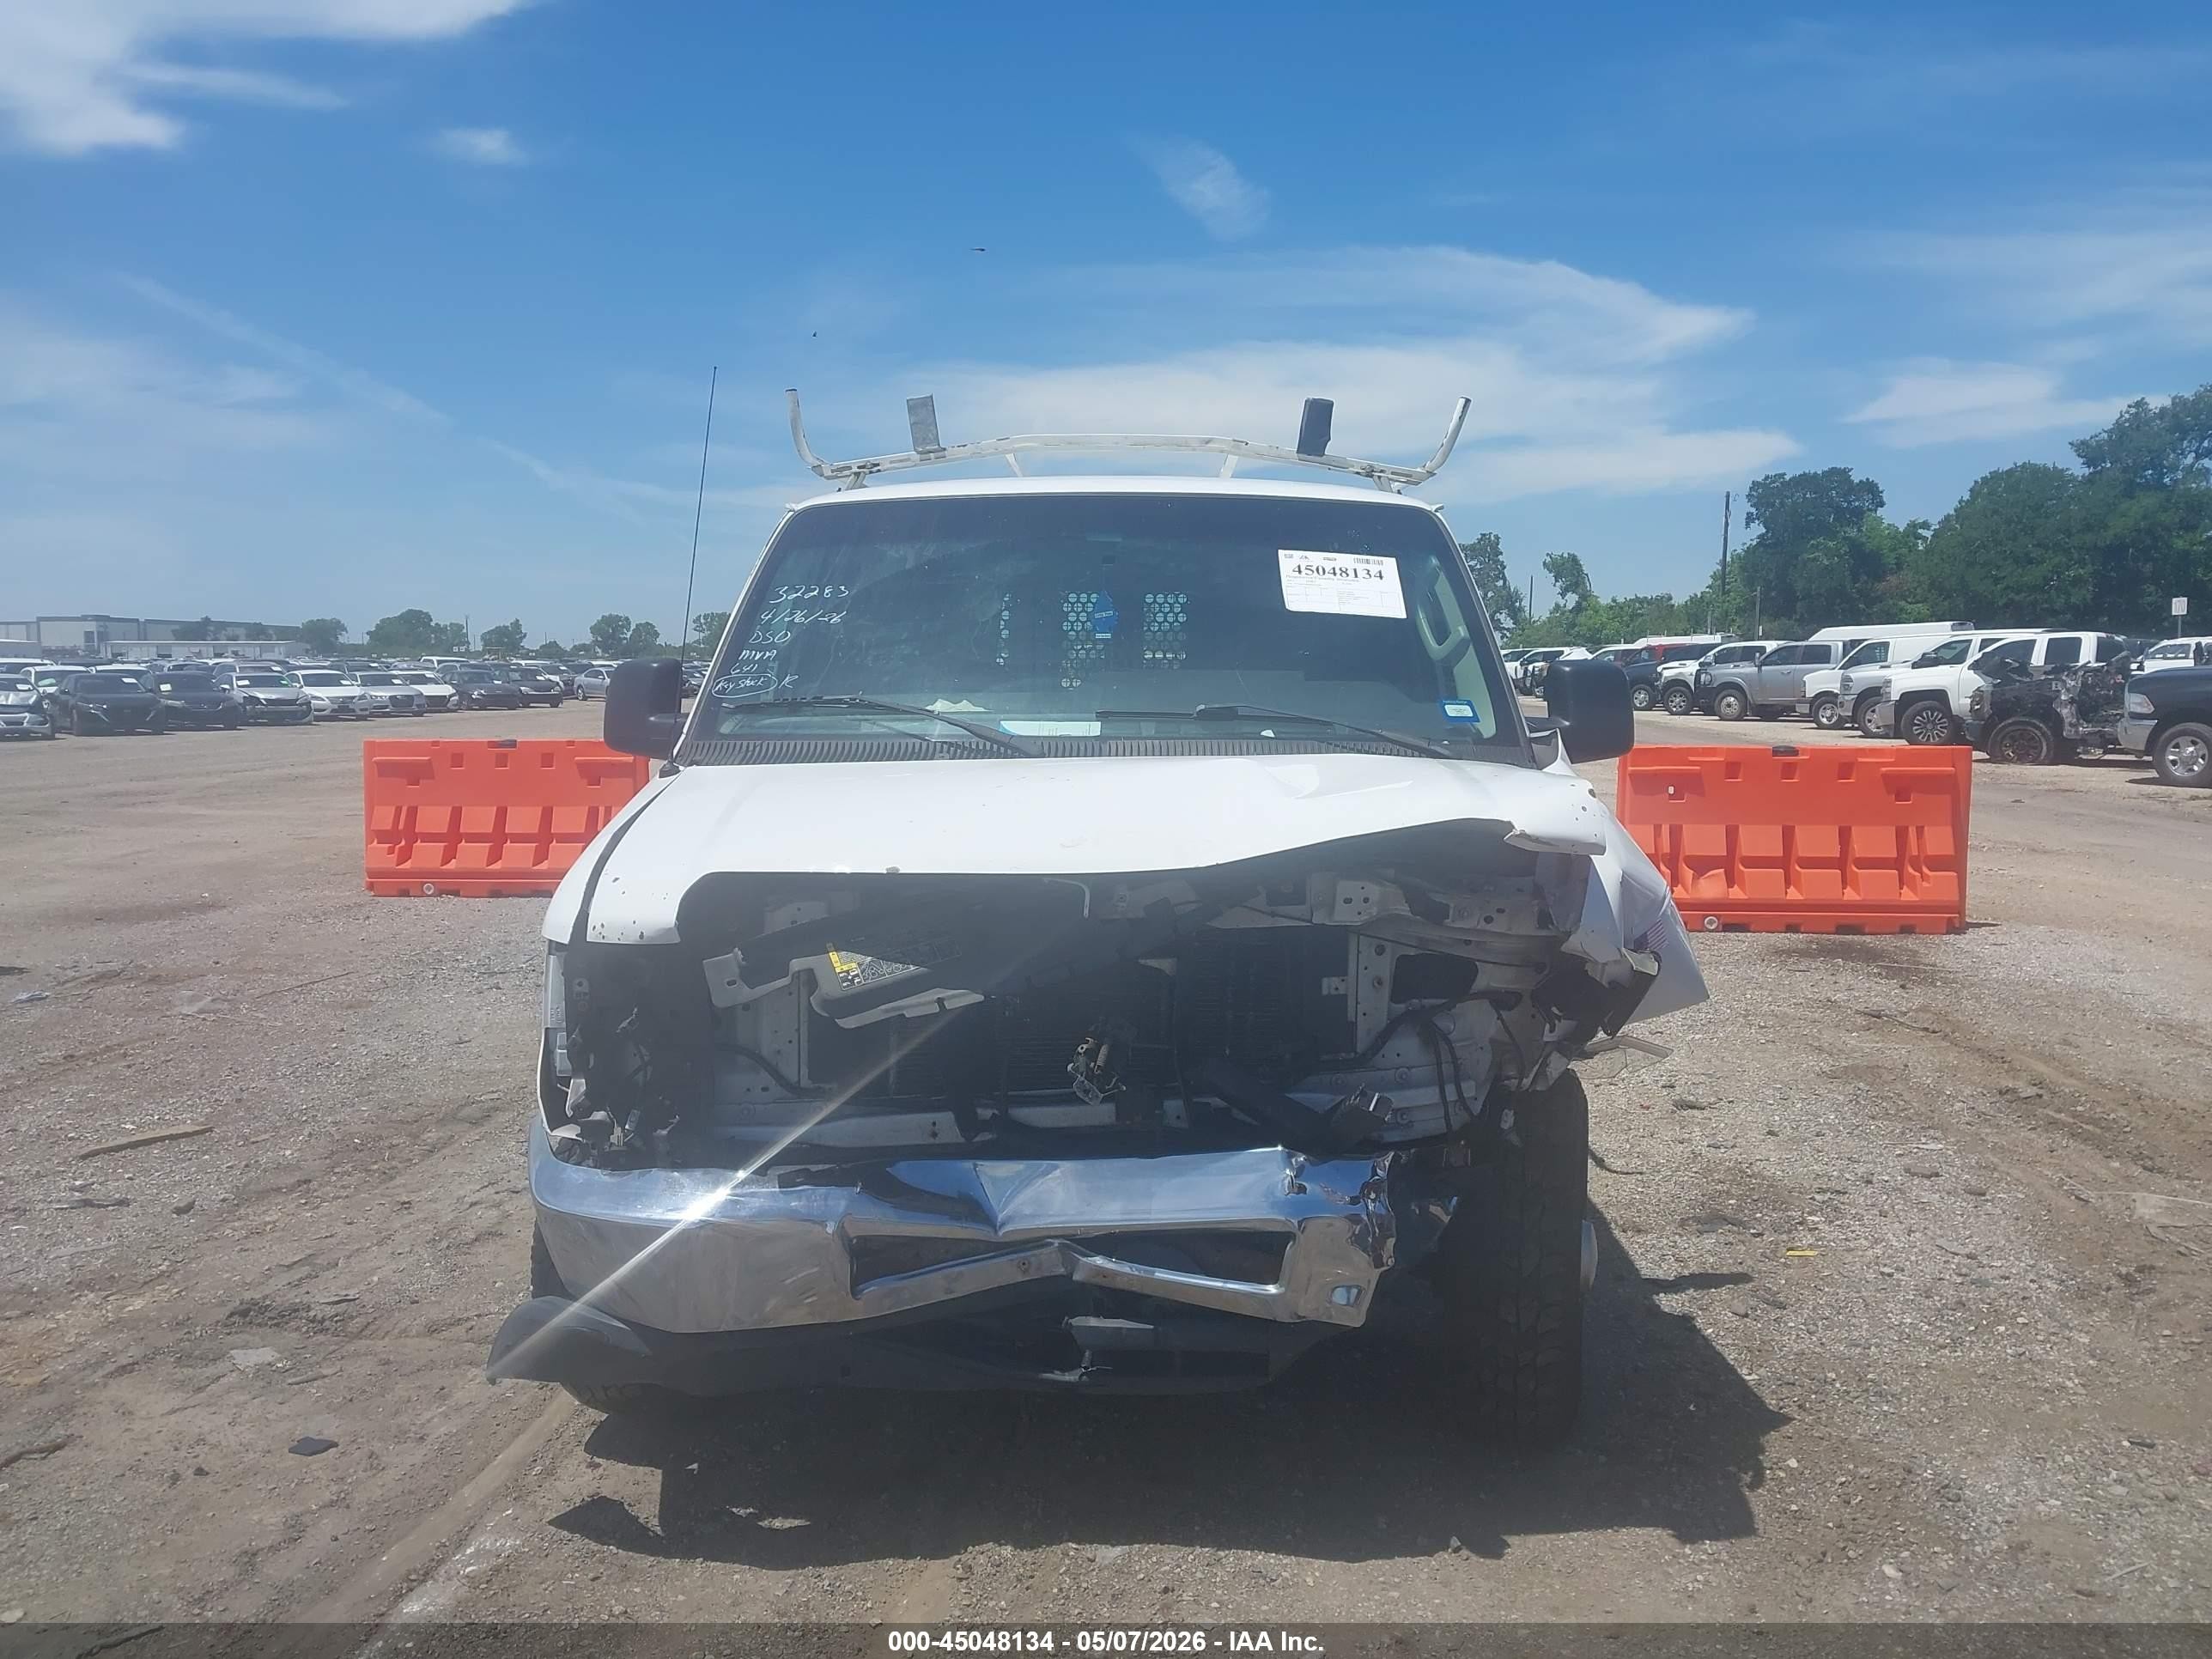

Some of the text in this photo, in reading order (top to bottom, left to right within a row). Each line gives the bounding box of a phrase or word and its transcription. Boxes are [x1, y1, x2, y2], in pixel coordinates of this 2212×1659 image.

[1291, 563, 1384, 581] 45048134
[769, 586, 850, 603] 32283
[761, 608, 848, 625] 4/26/26
